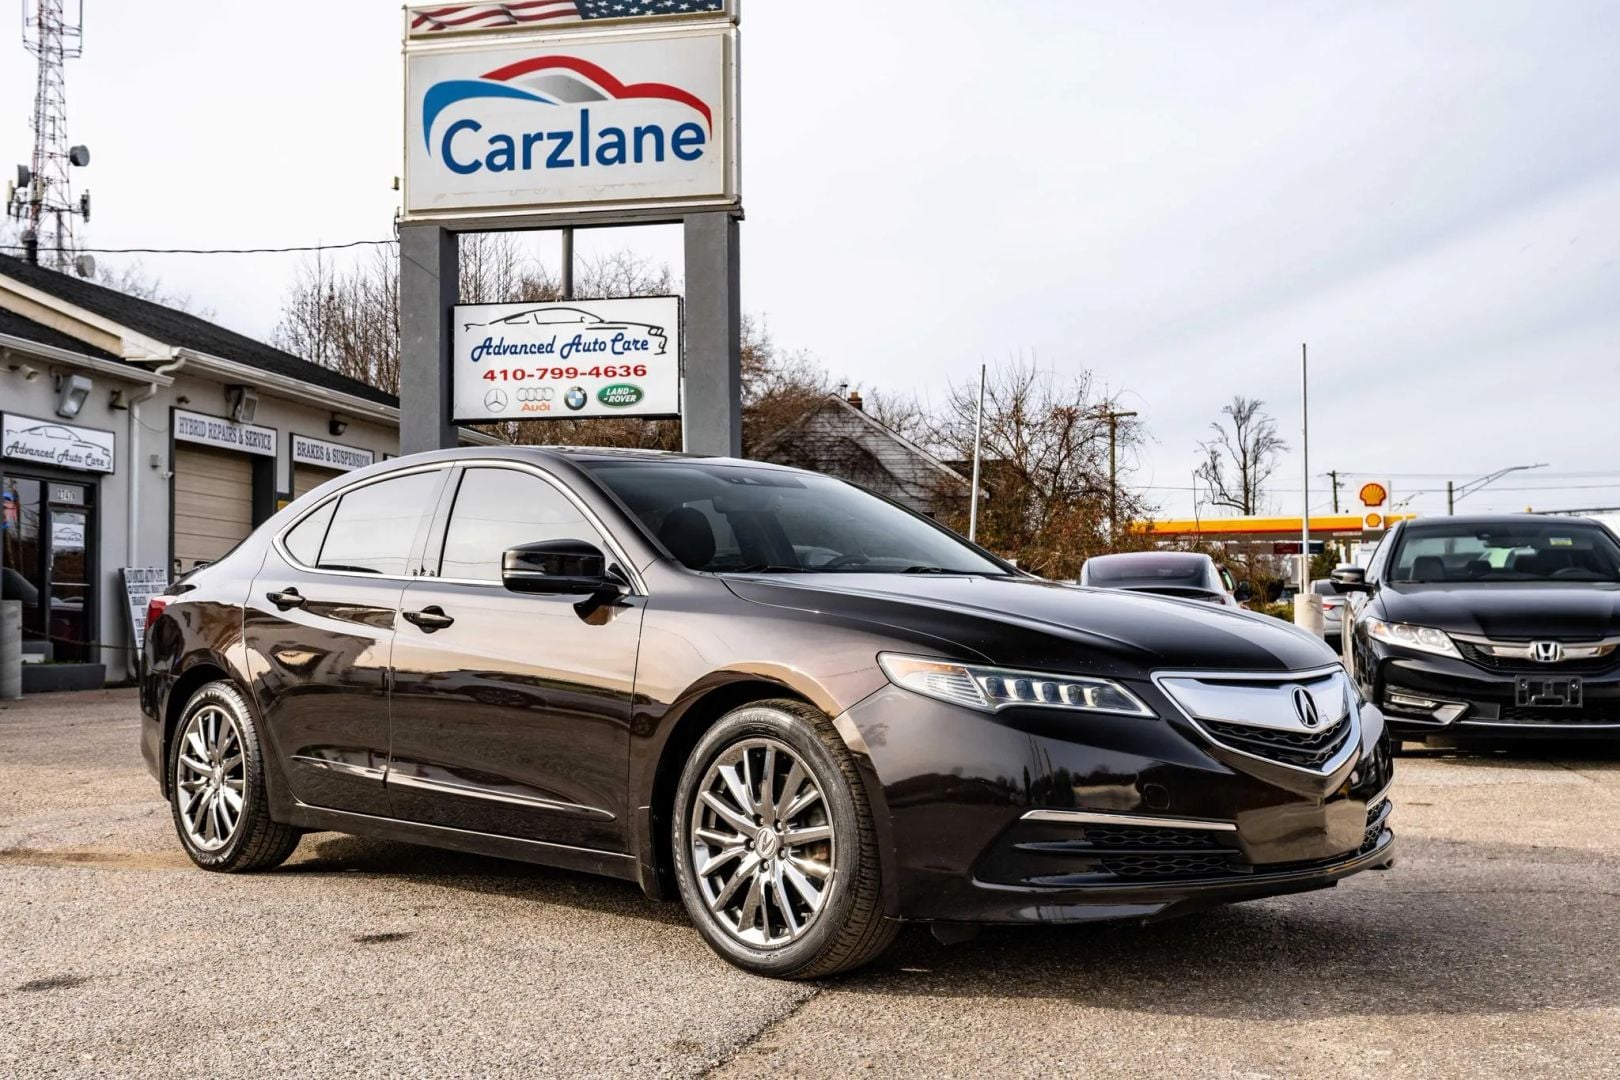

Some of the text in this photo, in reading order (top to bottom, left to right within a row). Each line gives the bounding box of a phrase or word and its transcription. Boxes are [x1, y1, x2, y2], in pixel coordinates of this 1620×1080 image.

[441, 108, 706, 175] Carzlane
[470, 332, 649, 363] Advanced Auto Care
[482, 364, 648, 382] 410-799-4636
[606, 387, 630, 396] LAND
[608, 394, 637, 403] ROVER
[521, 402, 551, 411] Audi
[178, 416, 272, 451] HYBRID REPAIRS & SERVICE
[5, 440, 105, 466] Advanced Auto Care
[296, 441, 371, 468] BRAKES & SUSPENSION
